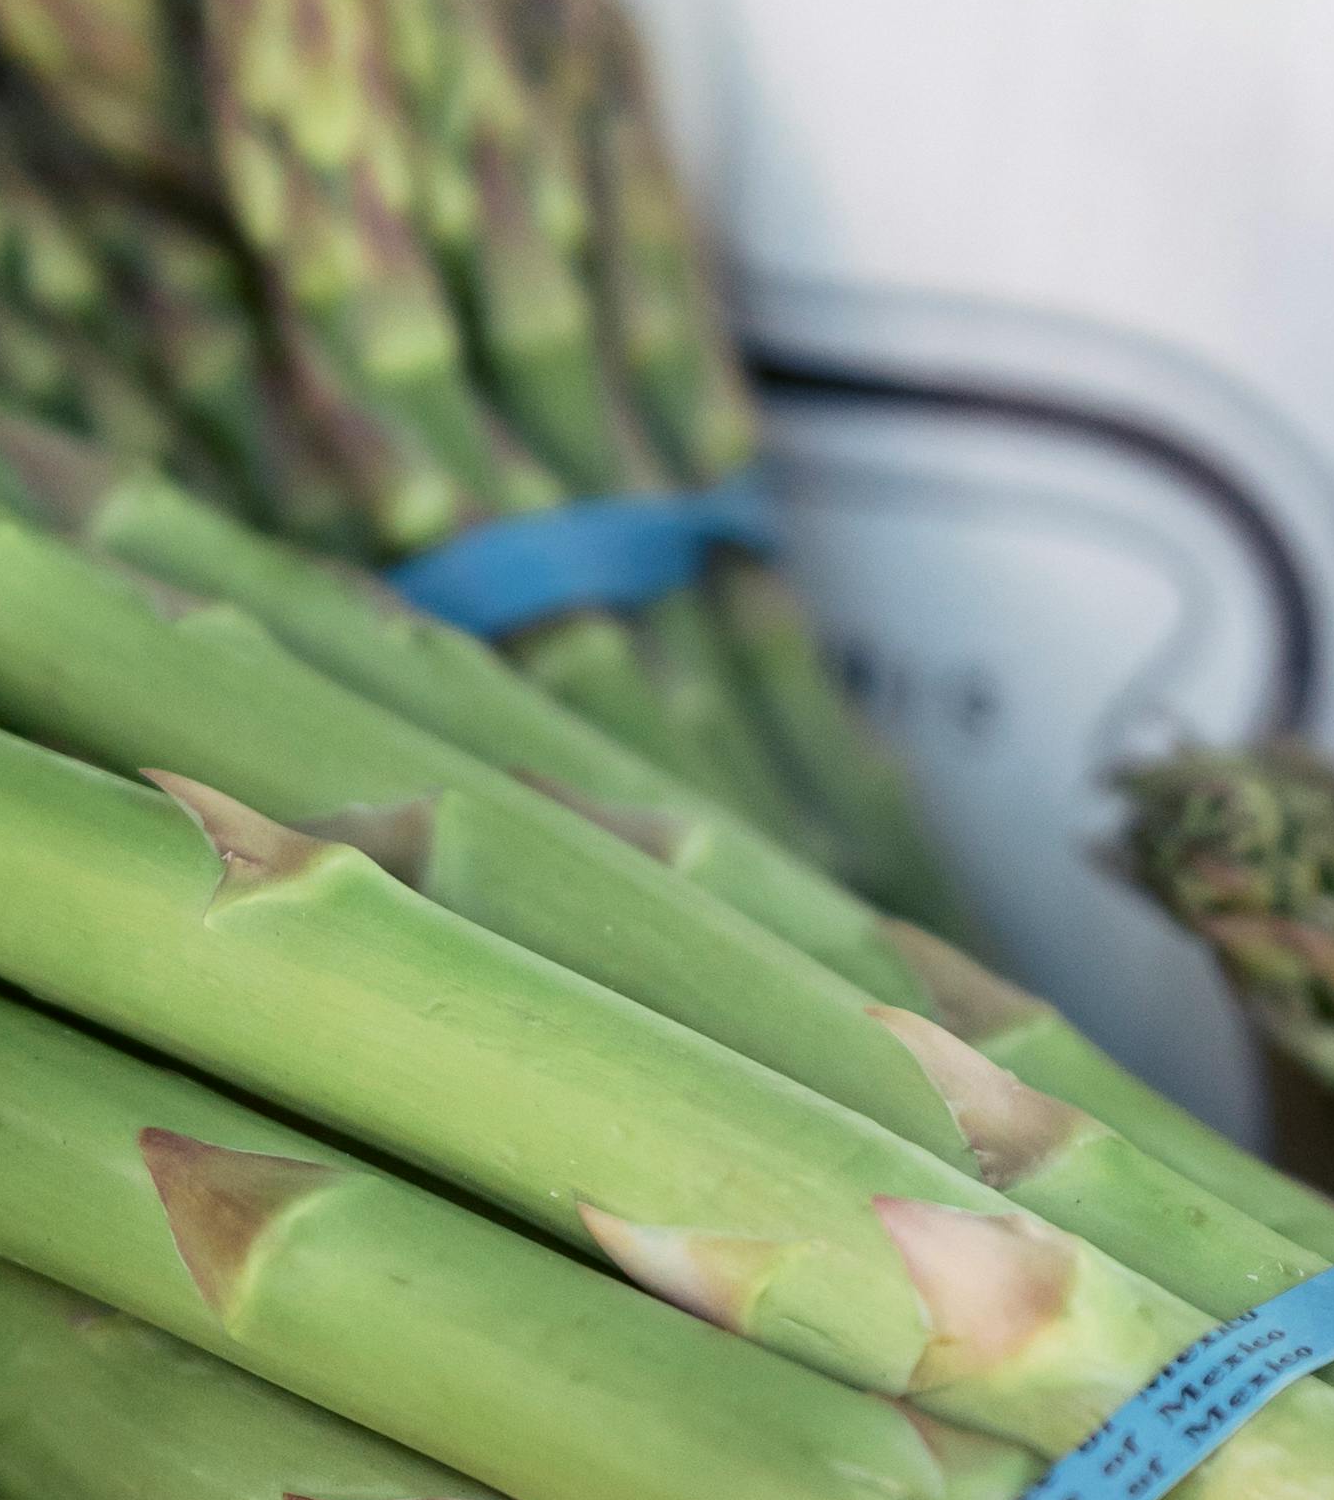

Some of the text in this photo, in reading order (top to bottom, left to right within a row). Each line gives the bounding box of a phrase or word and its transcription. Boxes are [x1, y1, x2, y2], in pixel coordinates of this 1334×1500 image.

[1101, 1431, 1139, 1477] of
[1155, 1328, 1287, 1427] Mexico
[1126, 1454, 1166, 1499] of
[1182, 1345, 1315, 1448] Mexico
